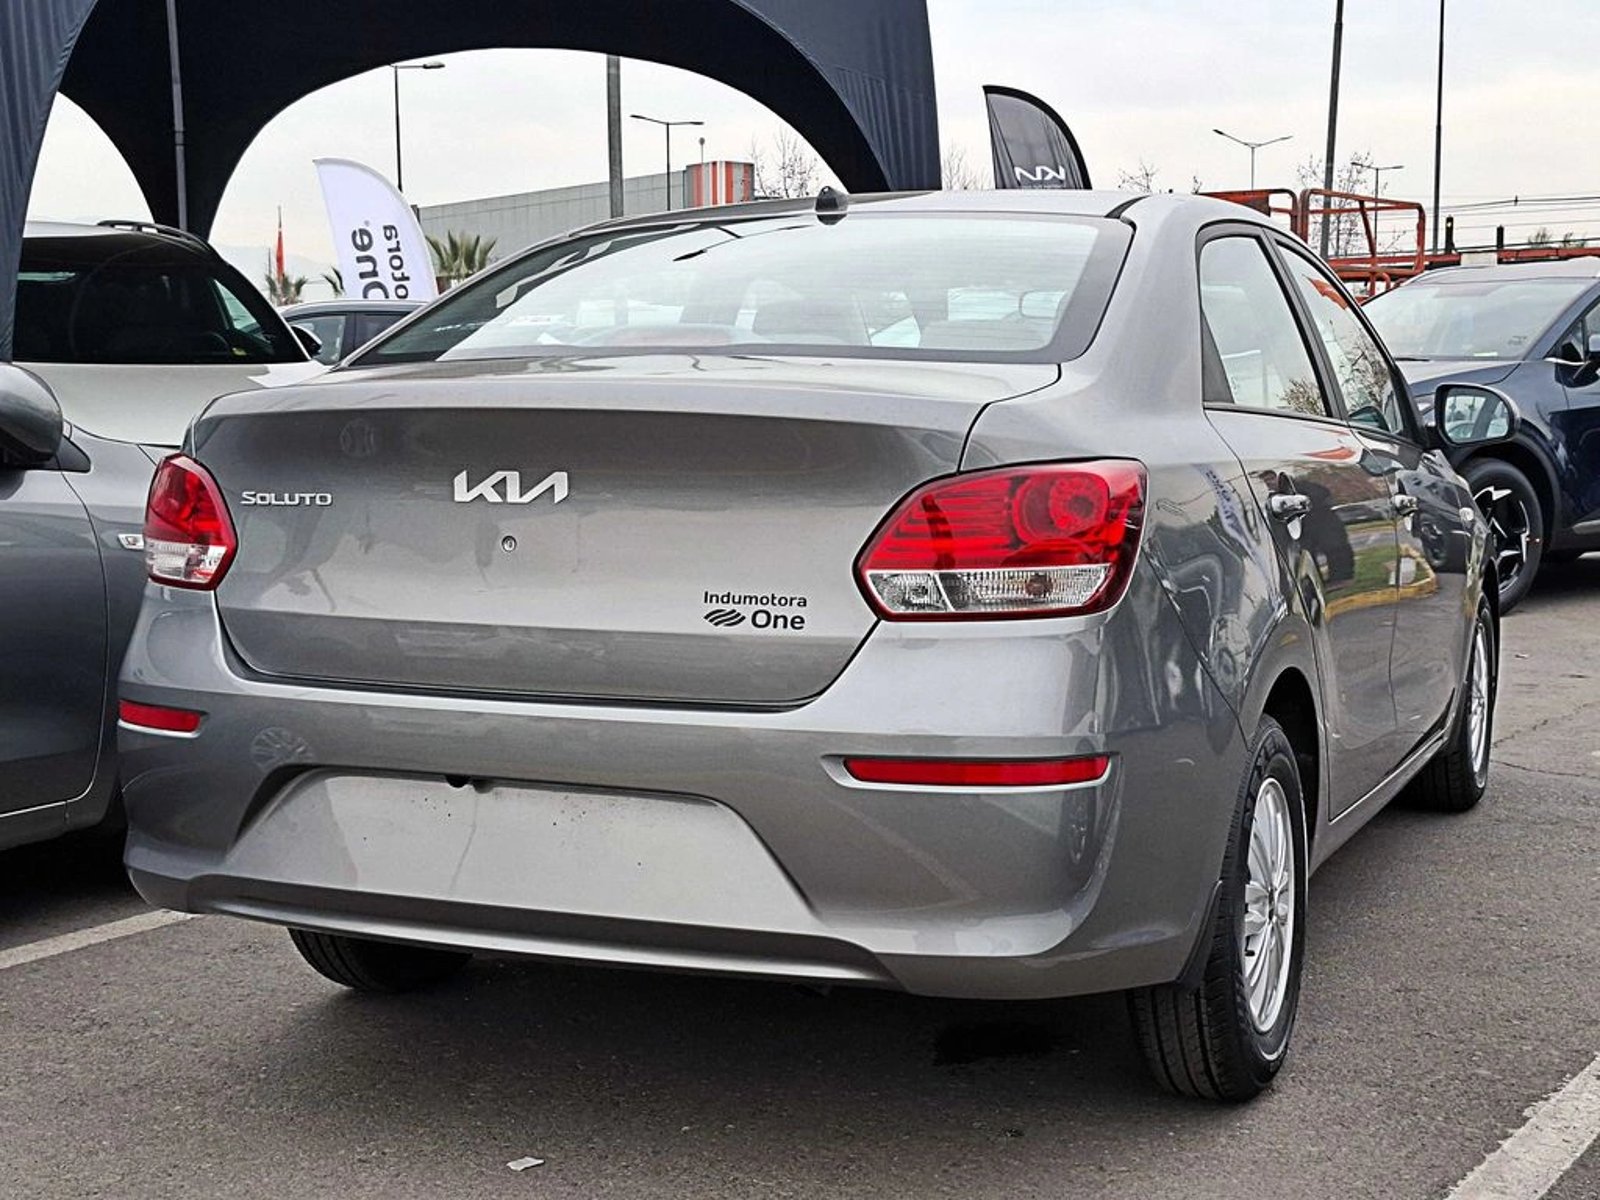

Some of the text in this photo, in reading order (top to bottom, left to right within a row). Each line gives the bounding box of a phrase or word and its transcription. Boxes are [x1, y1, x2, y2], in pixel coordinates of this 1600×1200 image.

[454, 470, 569, 504] KIA
[240, 491, 333, 506] SOLUTO
[703, 591, 807, 607] Indumotora
[751, 609, 805, 630] One
